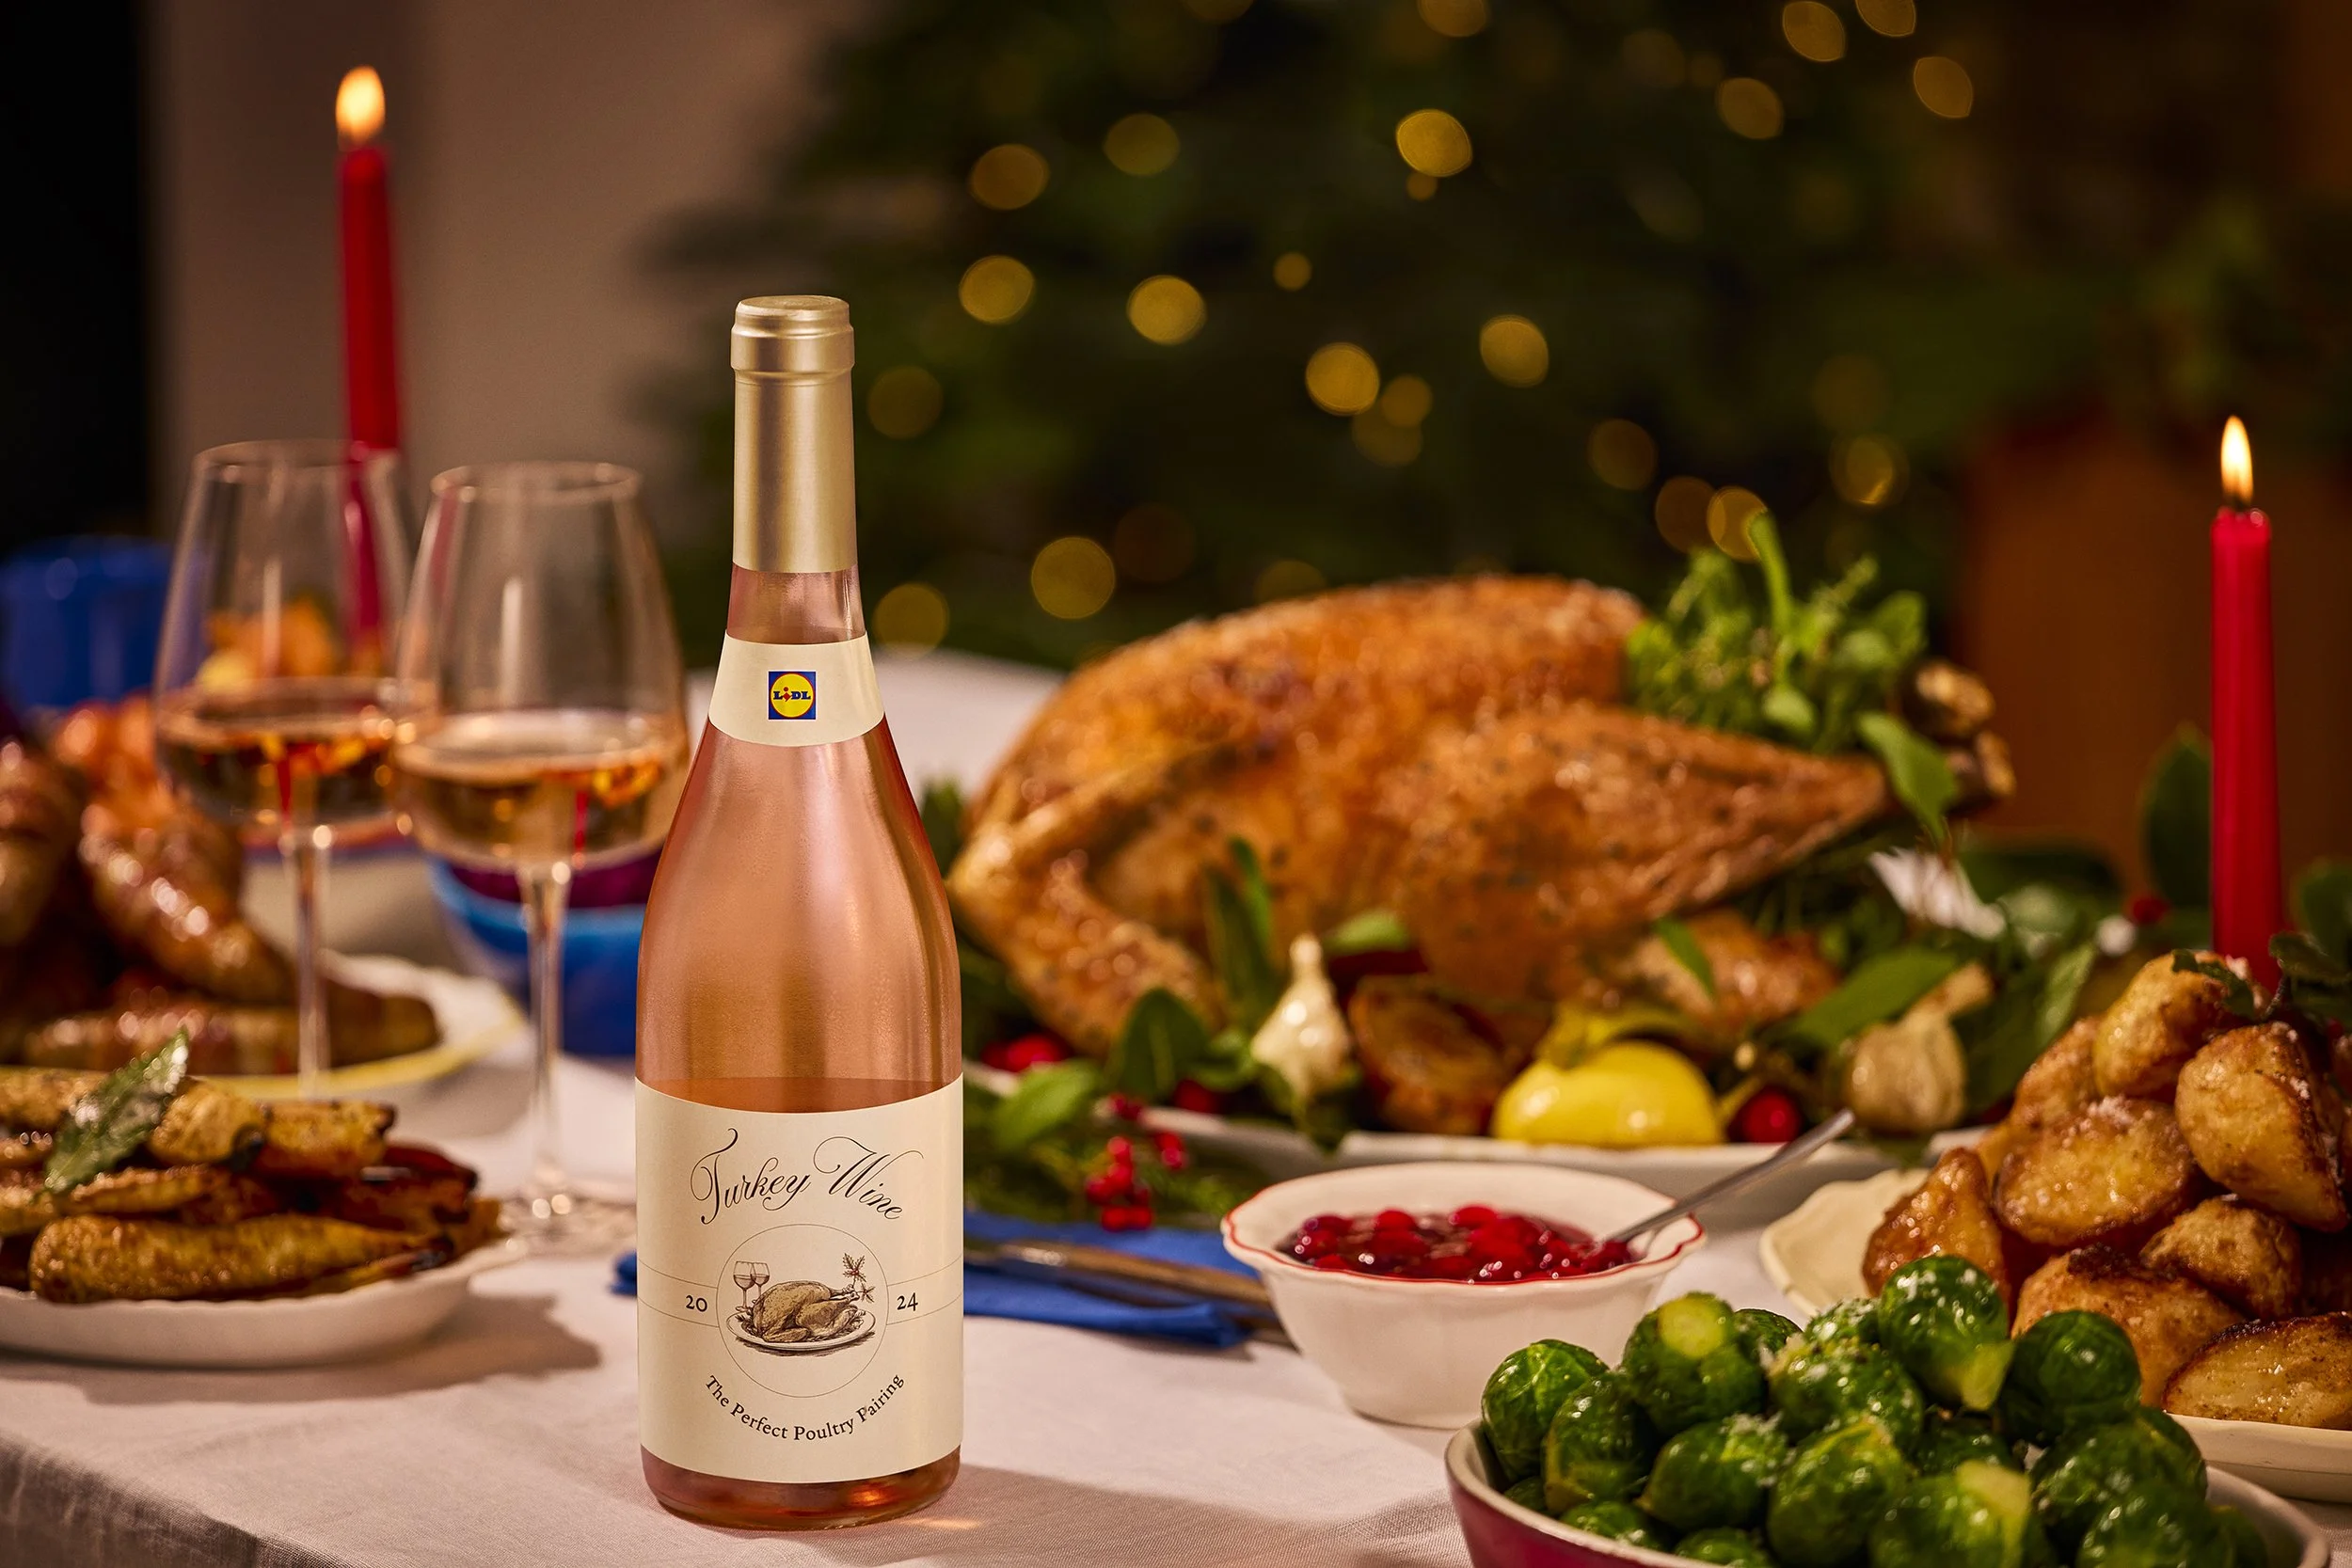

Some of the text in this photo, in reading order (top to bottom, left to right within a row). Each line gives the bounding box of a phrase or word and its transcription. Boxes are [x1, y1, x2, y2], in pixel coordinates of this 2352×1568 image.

[691, 1128, 924, 1225] Turkey Wine
[685, 1292, 918, 1312] 20 24
[706, 1374, 905, 1440] The Perfect Poultry Pairing
